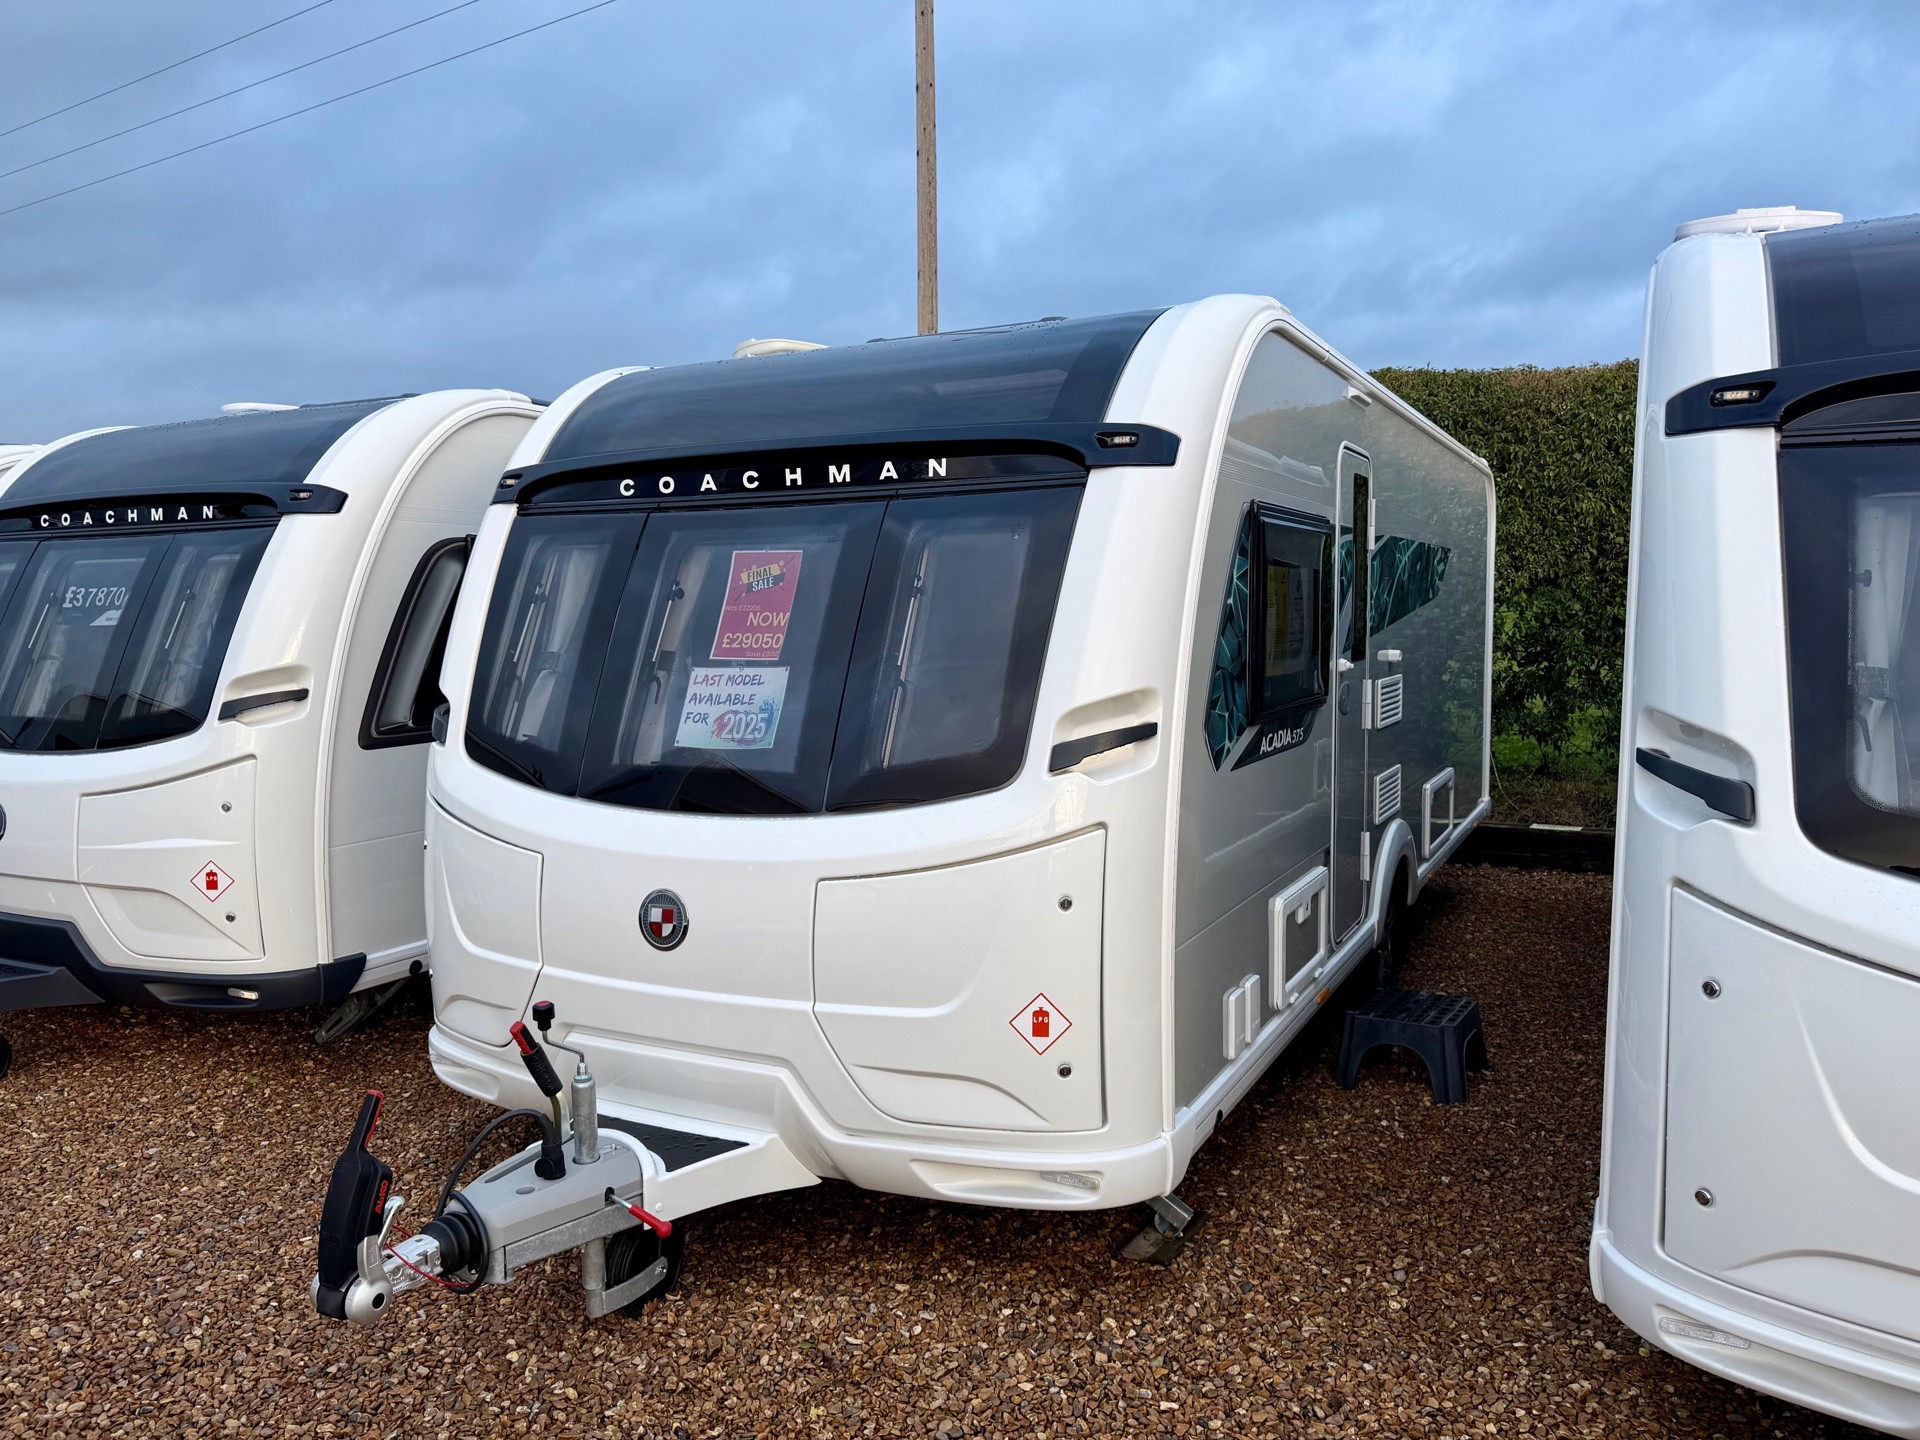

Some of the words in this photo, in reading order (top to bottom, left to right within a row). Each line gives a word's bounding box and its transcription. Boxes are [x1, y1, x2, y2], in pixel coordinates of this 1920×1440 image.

[619, 457, 948, 497] COACHMAN
[40, 505, 214, 528] COACHMAN
[747, 566, 774, 582] FINAL
[752, 576, 774, 592] SALE
[62, 586, 126, 608] £37870
[746, 611, 790, 627] NOW
[721, 632, 784, 649] £29050
[692, 673, 725, 687] LAST
[725, 673, 765, 687] MODEL
[688, 692, 756, 707] AVAILABLE
[684, 711, 710, 726] FOR
[720, 711, 769, 740] 2025
[1259, 728, 1292, 755] ACADIA
[1292, 727, 1304, 744] 575
